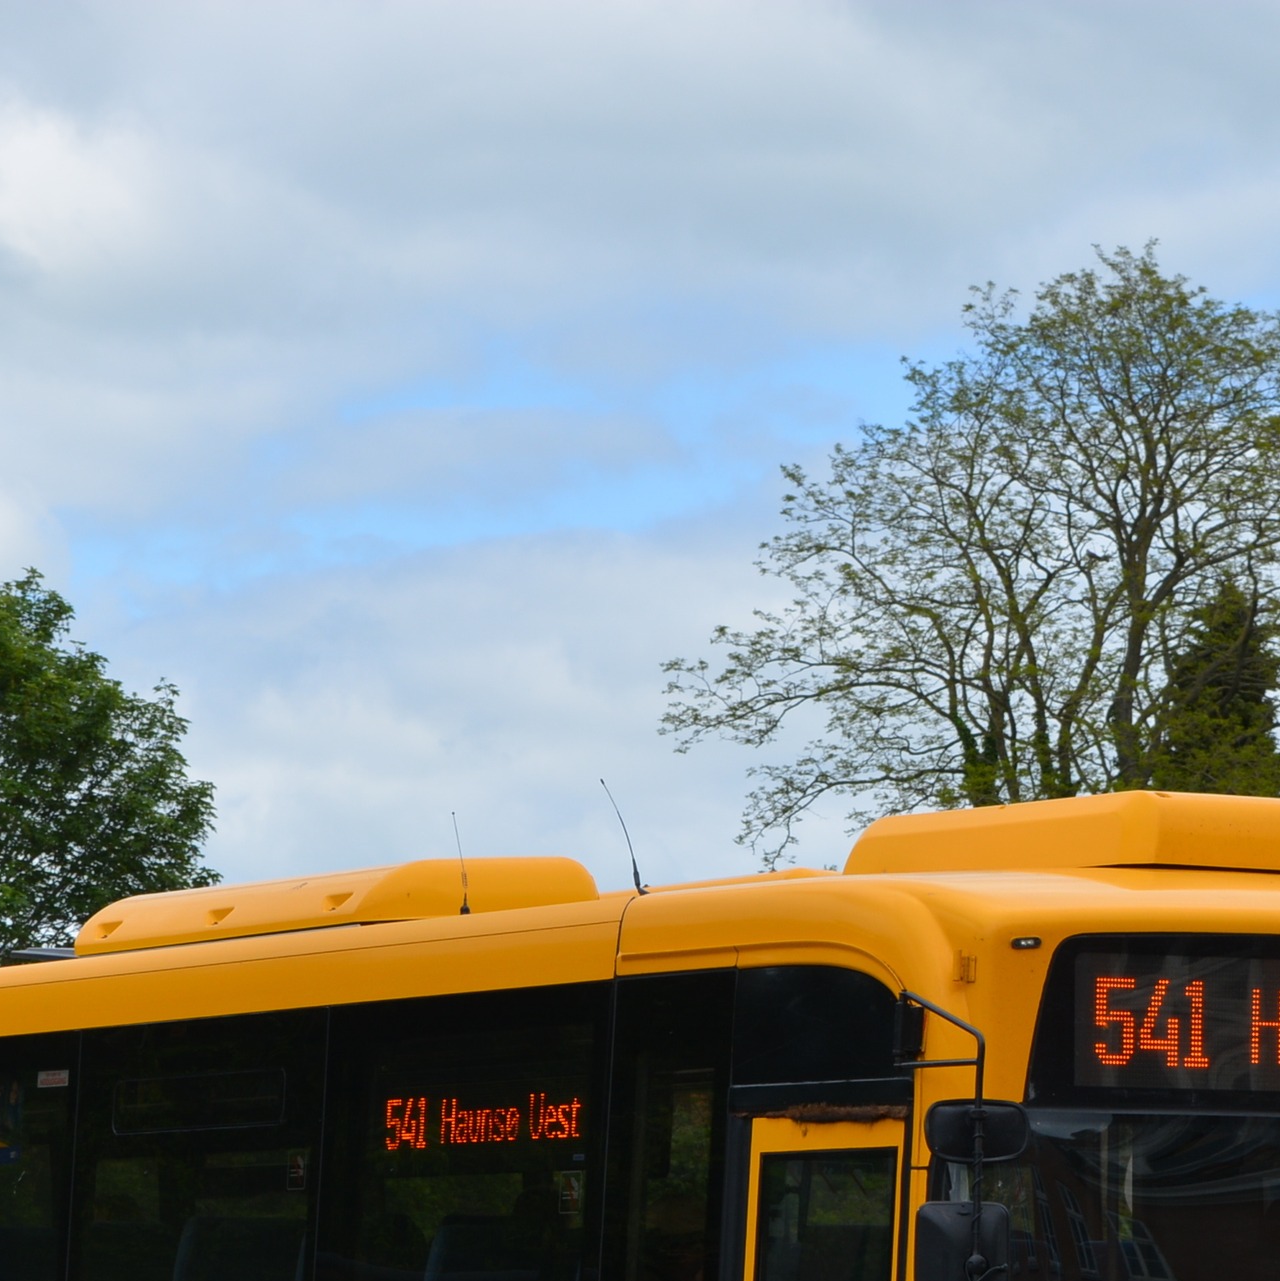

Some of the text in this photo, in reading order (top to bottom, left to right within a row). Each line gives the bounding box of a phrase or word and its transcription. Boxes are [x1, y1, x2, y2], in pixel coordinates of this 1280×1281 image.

[1094, 977, 1210, 1068] 541
[385, 1092, 581, 1150] 541 Havnsø Vest
